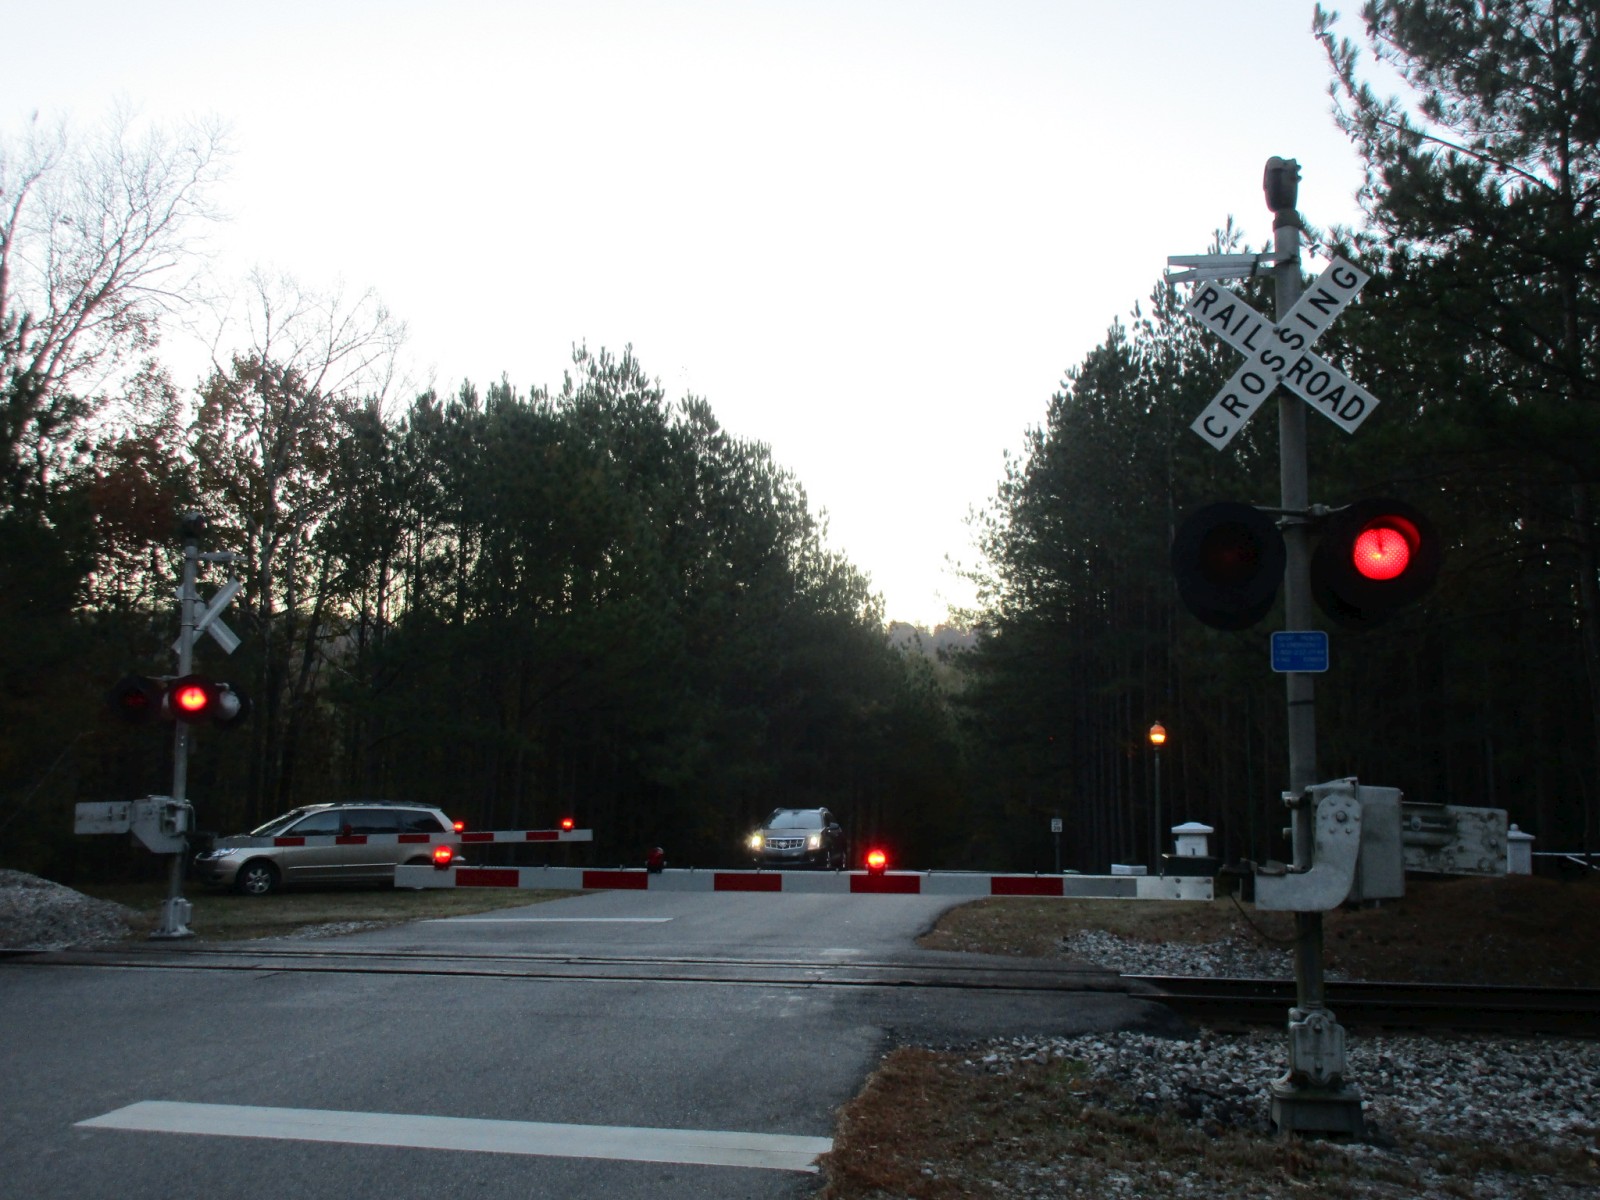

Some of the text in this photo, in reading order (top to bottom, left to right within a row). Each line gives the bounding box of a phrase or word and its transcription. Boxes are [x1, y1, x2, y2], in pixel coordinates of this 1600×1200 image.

[1192, 287, 1365, 422] RAIL ROAD
[1203, 266, 1358, 439] CROSSING
